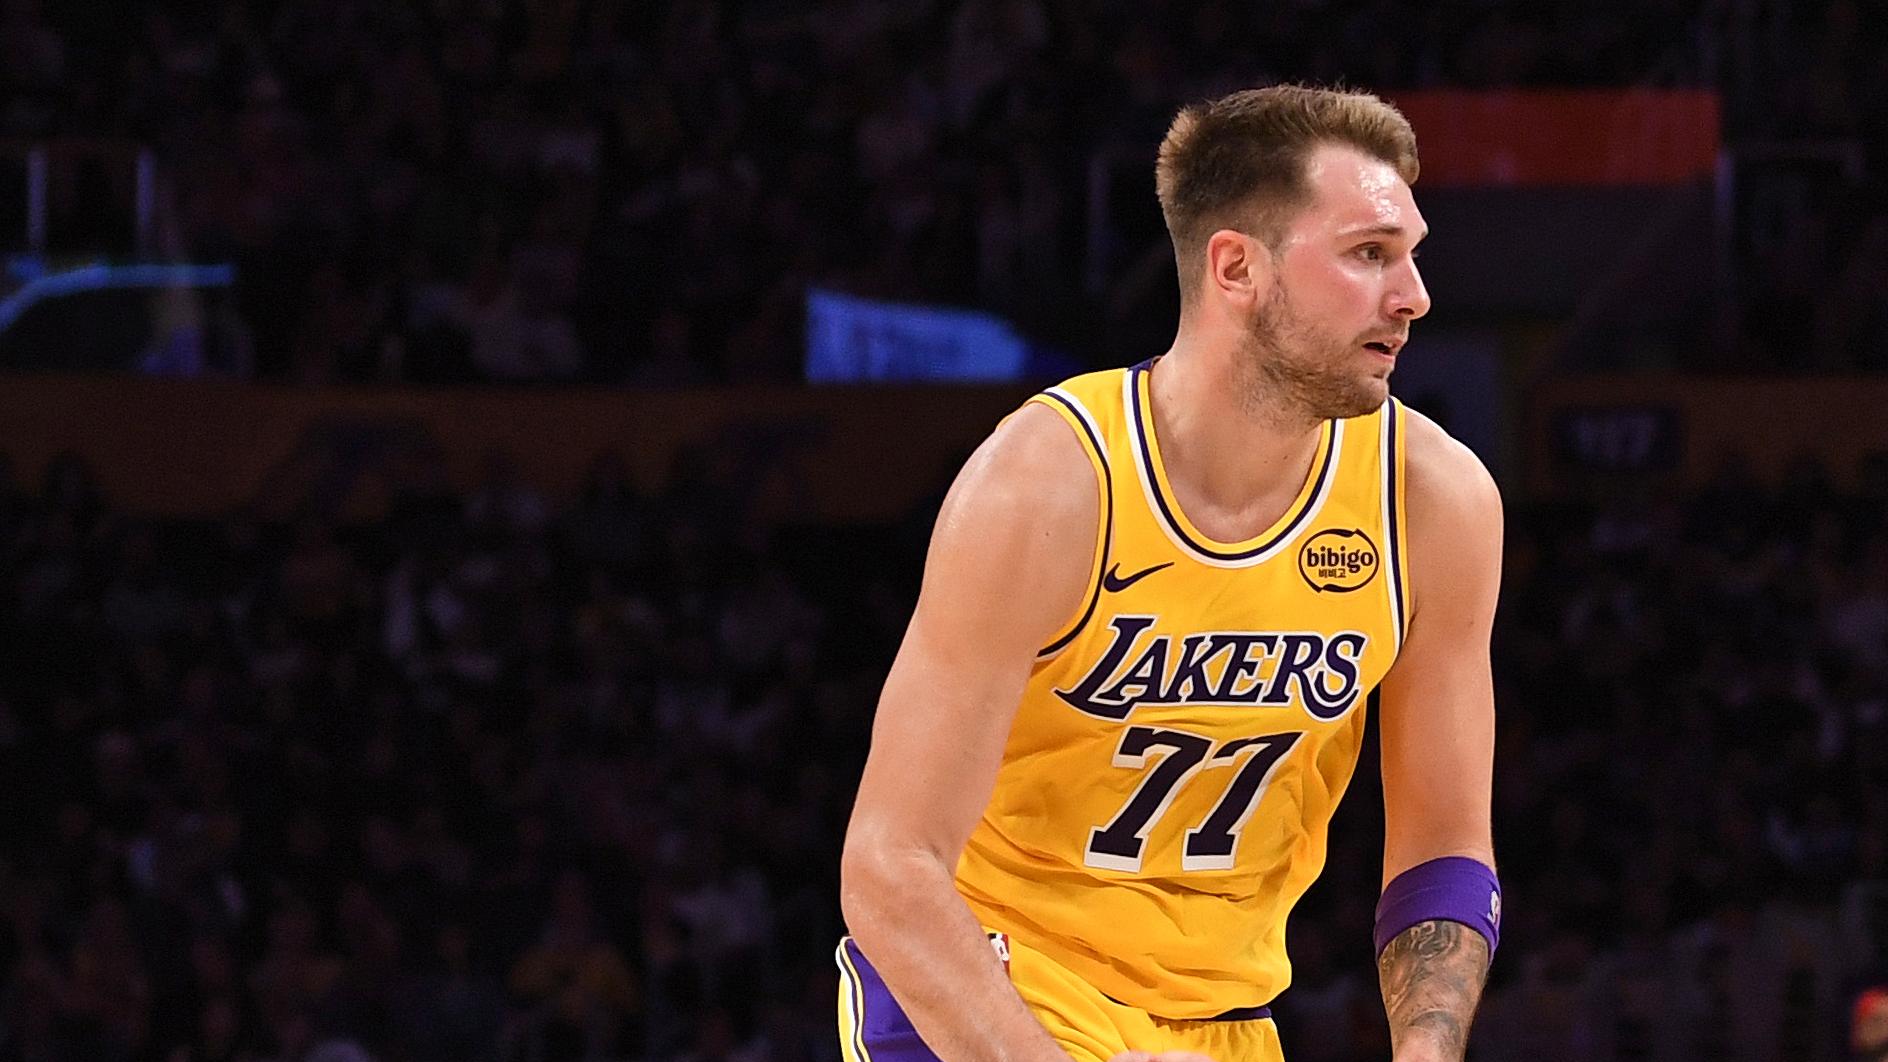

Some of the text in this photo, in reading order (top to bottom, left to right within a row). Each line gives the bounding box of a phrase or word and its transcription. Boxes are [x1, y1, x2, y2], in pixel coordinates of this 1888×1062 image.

[1306, 545, 1374, 574] bibigo
[1054, 614, 1368, 721] LAKERS
[1083, 726, 1304, 871] 77
